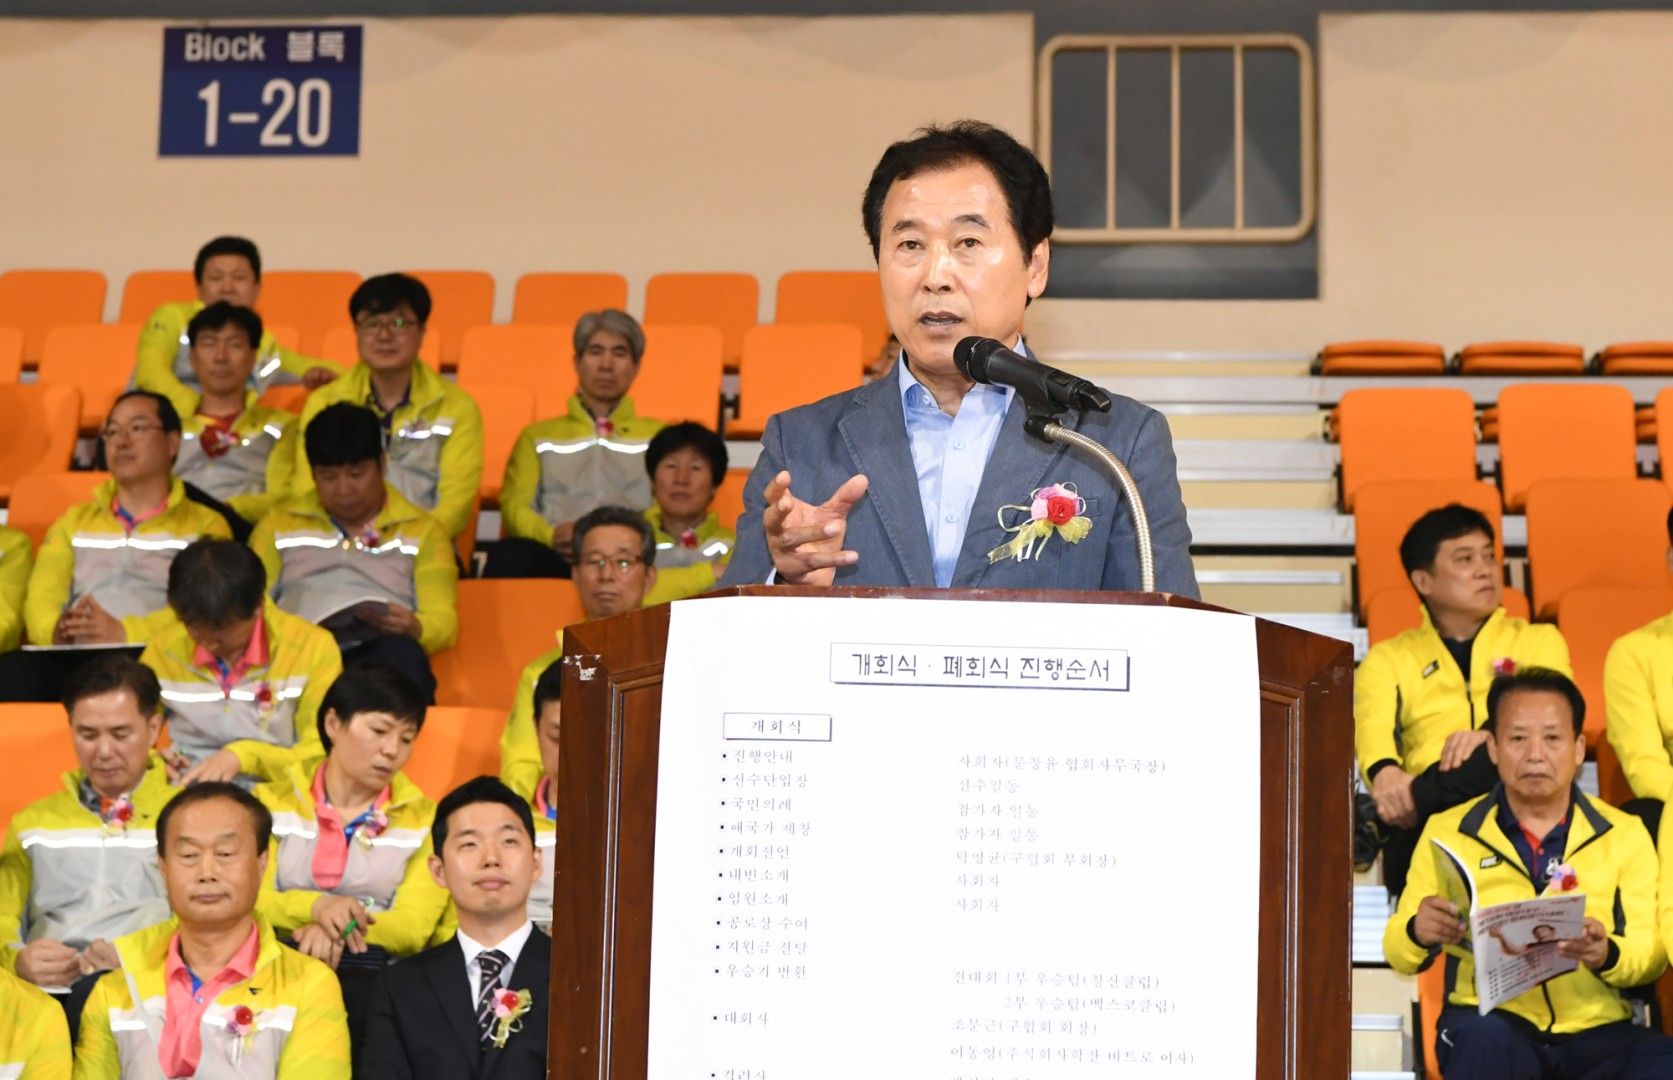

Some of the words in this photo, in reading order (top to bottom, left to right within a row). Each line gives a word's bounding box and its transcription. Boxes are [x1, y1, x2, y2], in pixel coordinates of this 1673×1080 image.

[184, 33, 265, 61] Block
[287, 30, 345, 63] 블록
[198, 79, 332, 147] 1-20
[851, 653, 917, 678] 개회식
[942, 655, 1009, 680] 폐회식
[1019, 657, 1110, 682] 진행순서
[752, 718, 801, 735] 개회식
[734, 748, 793, 764] 진행안내
[733, 772, 809, 788] 선수단입장
[959, 778, 1019, 794] 선수일동
[959, 802, 1003, 818] 참가자
[1009, 804, 1039, 819] 일동
[730, 820, 775, 835] 애국가
[783, 821, 810, 837] 제창
[958, 826, 1002, 841] 참가자
[1008, 827, 1039, 843] 일동
[730, 844, 789, 860] 개회선언
[1063, 852, 1117, 869] 부회장)
[729, 867, 789, 883] 내빈소개
[957, 873, 1001, 889] 사회자
[728, 891, 788, 907] 임원소개
[956, 897, 1001, 913] 사회자
[727, 915, 771, 931] 공로상
[779, 916, 808, 932] 수여
[727, 939, 771, 955] 지원금
[780, 940, 807, 956] 전달
[726, 963, 769, 979] 우승기
[777, 964, 806, 980] 반환
[953, 969, 998, 985] 전대회
[1007, 971, 1028, 986] 1부
[1004, 995, 1027, 1010] 2부
[724, 1010, 768, 1026] 대회사
[1059, 1020, 1097, 1036] 회장)
[1160, 1050, 1194, 1065] 이사)
